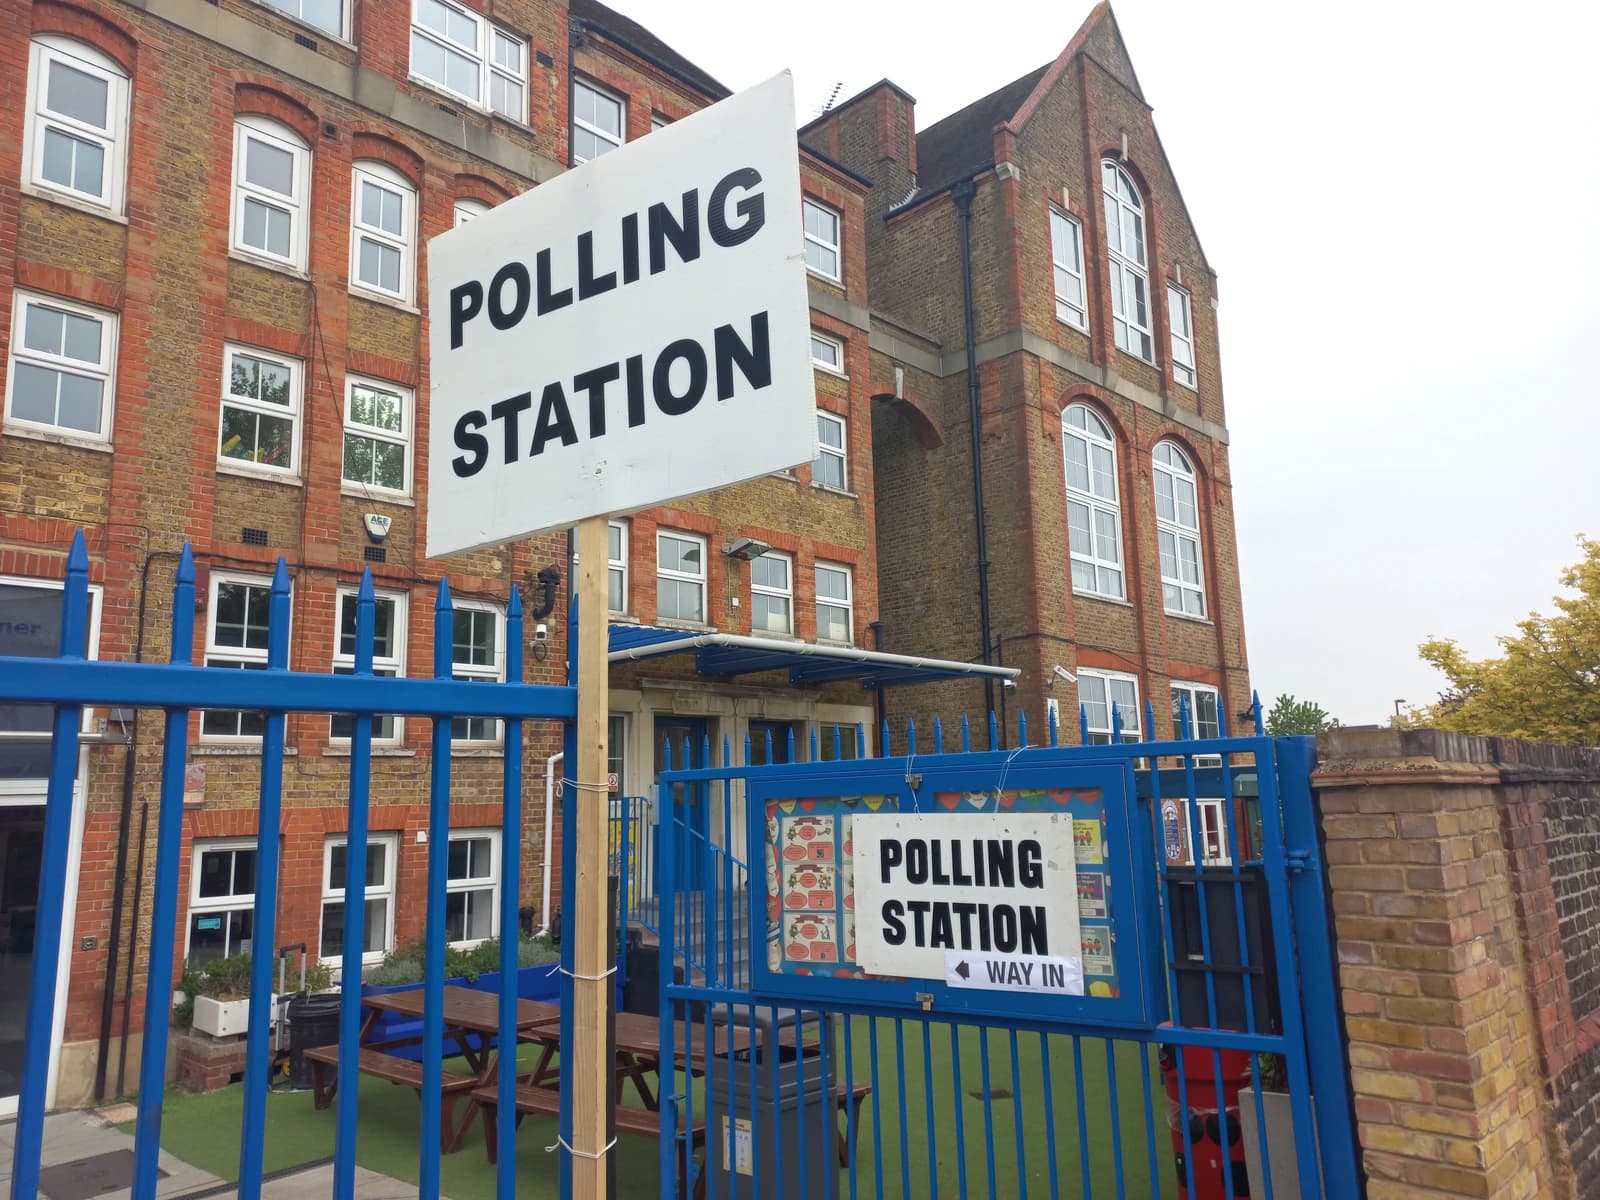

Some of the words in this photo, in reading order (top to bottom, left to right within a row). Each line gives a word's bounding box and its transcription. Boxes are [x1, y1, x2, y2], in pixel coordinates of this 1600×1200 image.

[451, 168, 764, 349] POLLING
[453, 311, 771, 477] STATION
[880, 839, 1043, 889] POLLING
[882, 900, 1048, 956] STATION
[986, 960, 1034, 986] WAY
[1042, 963, 1065, 988] IN
